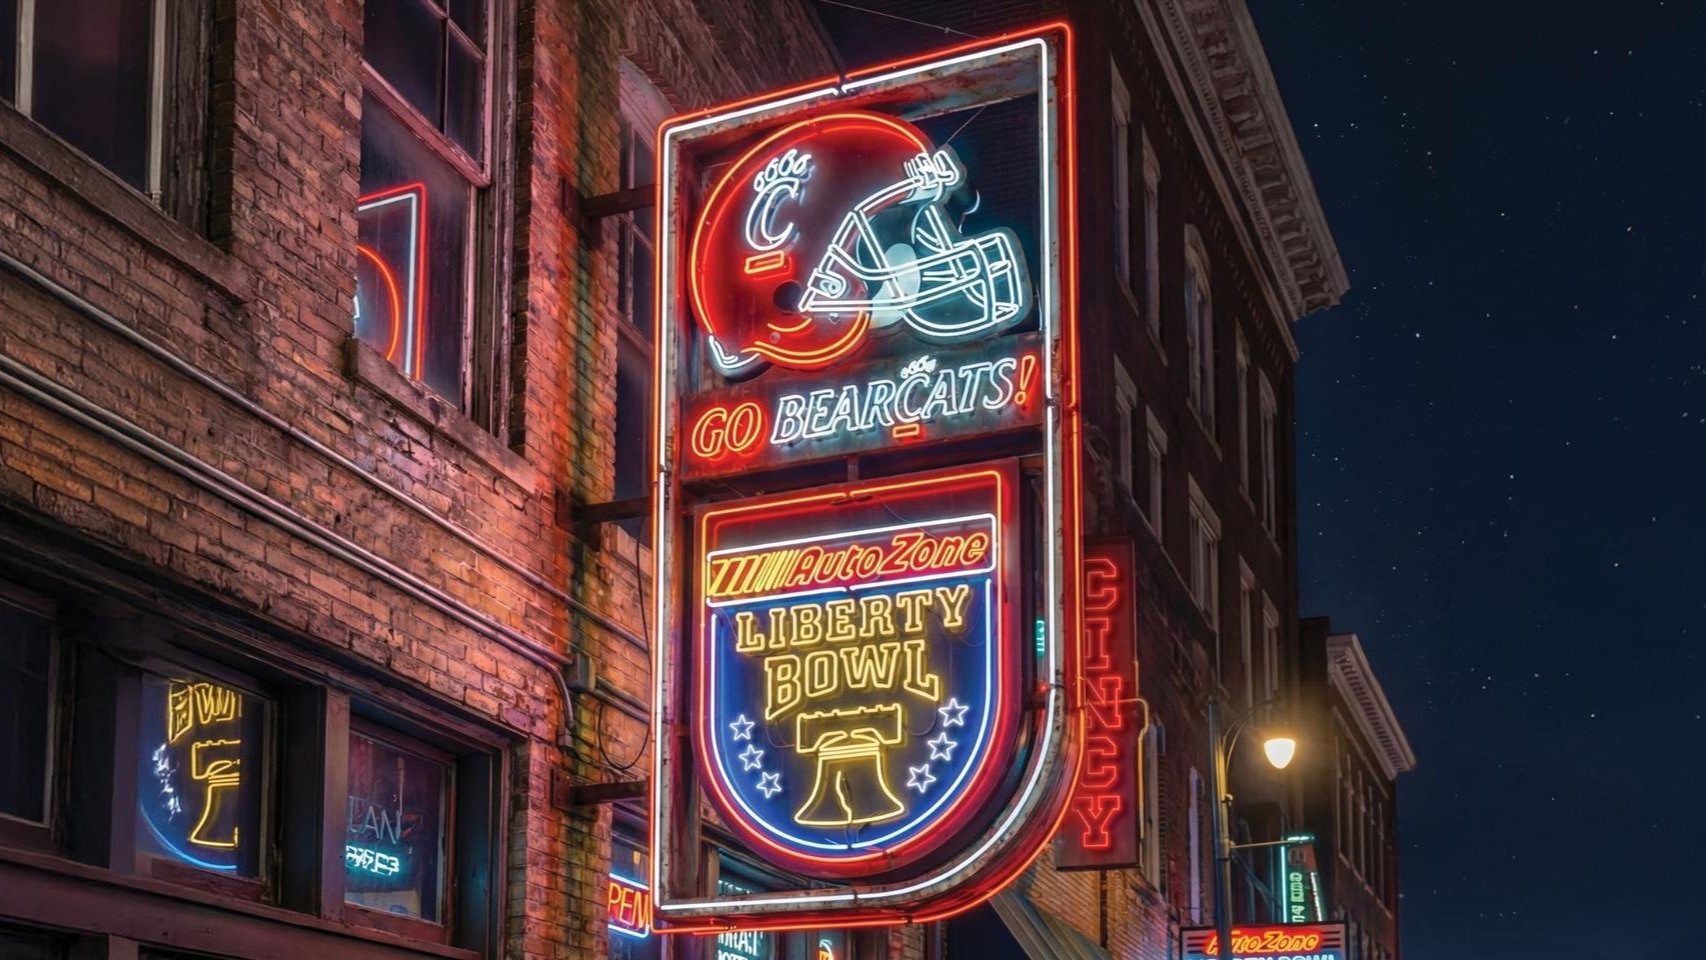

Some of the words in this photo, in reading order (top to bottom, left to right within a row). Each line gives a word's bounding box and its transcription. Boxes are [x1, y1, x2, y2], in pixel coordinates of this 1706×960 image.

[691, 402, 762, 457] GO
[770, 354, 1036, 444] BEARCATS!
[786, 532, 989, 586] AutoZone
[735, 584, 969, 652] LIBERTY
[764, 640, 939, 720] BOWL
[1073, 558, 1122, 847] CINCY
[609, 883, 649, 928] PEN
